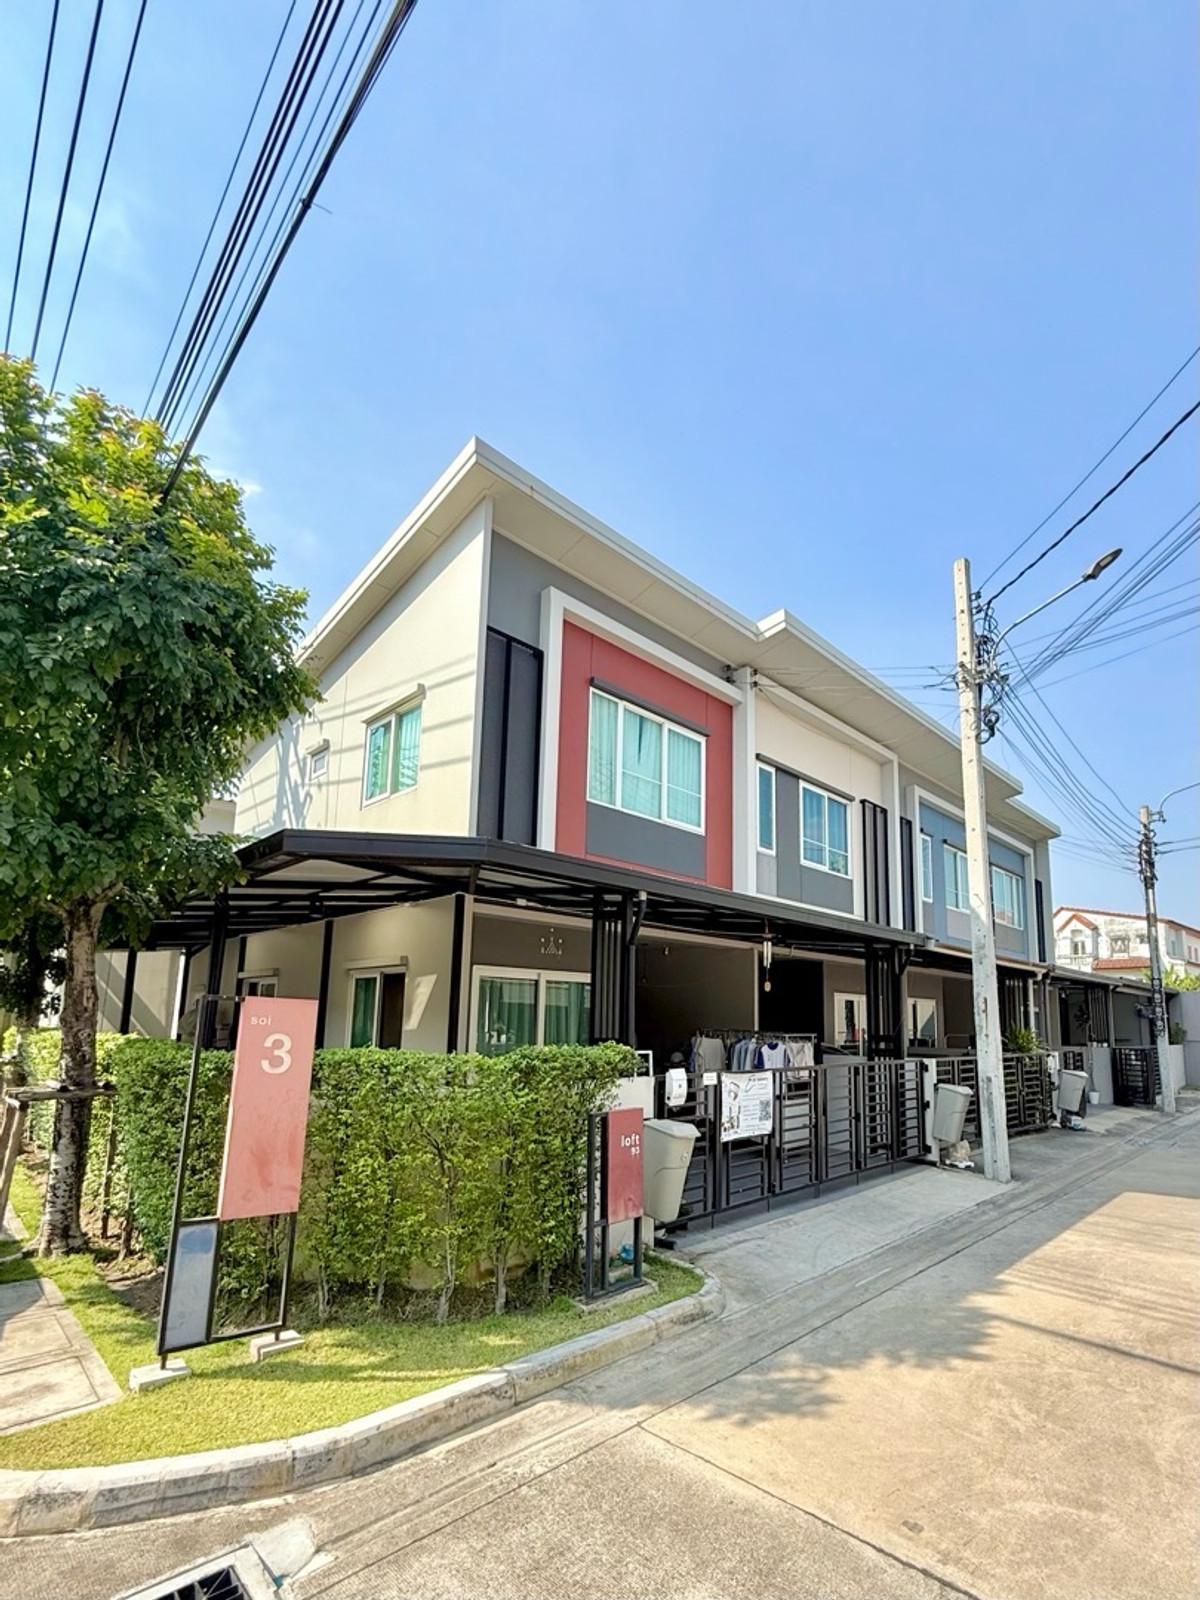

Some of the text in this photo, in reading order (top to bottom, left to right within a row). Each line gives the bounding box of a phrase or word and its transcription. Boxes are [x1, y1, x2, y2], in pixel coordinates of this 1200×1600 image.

[250, 1015, 271, 1025] soi
[261, 1032, 292, 1074] 3
[621, 1133, 640, 1147] loft
